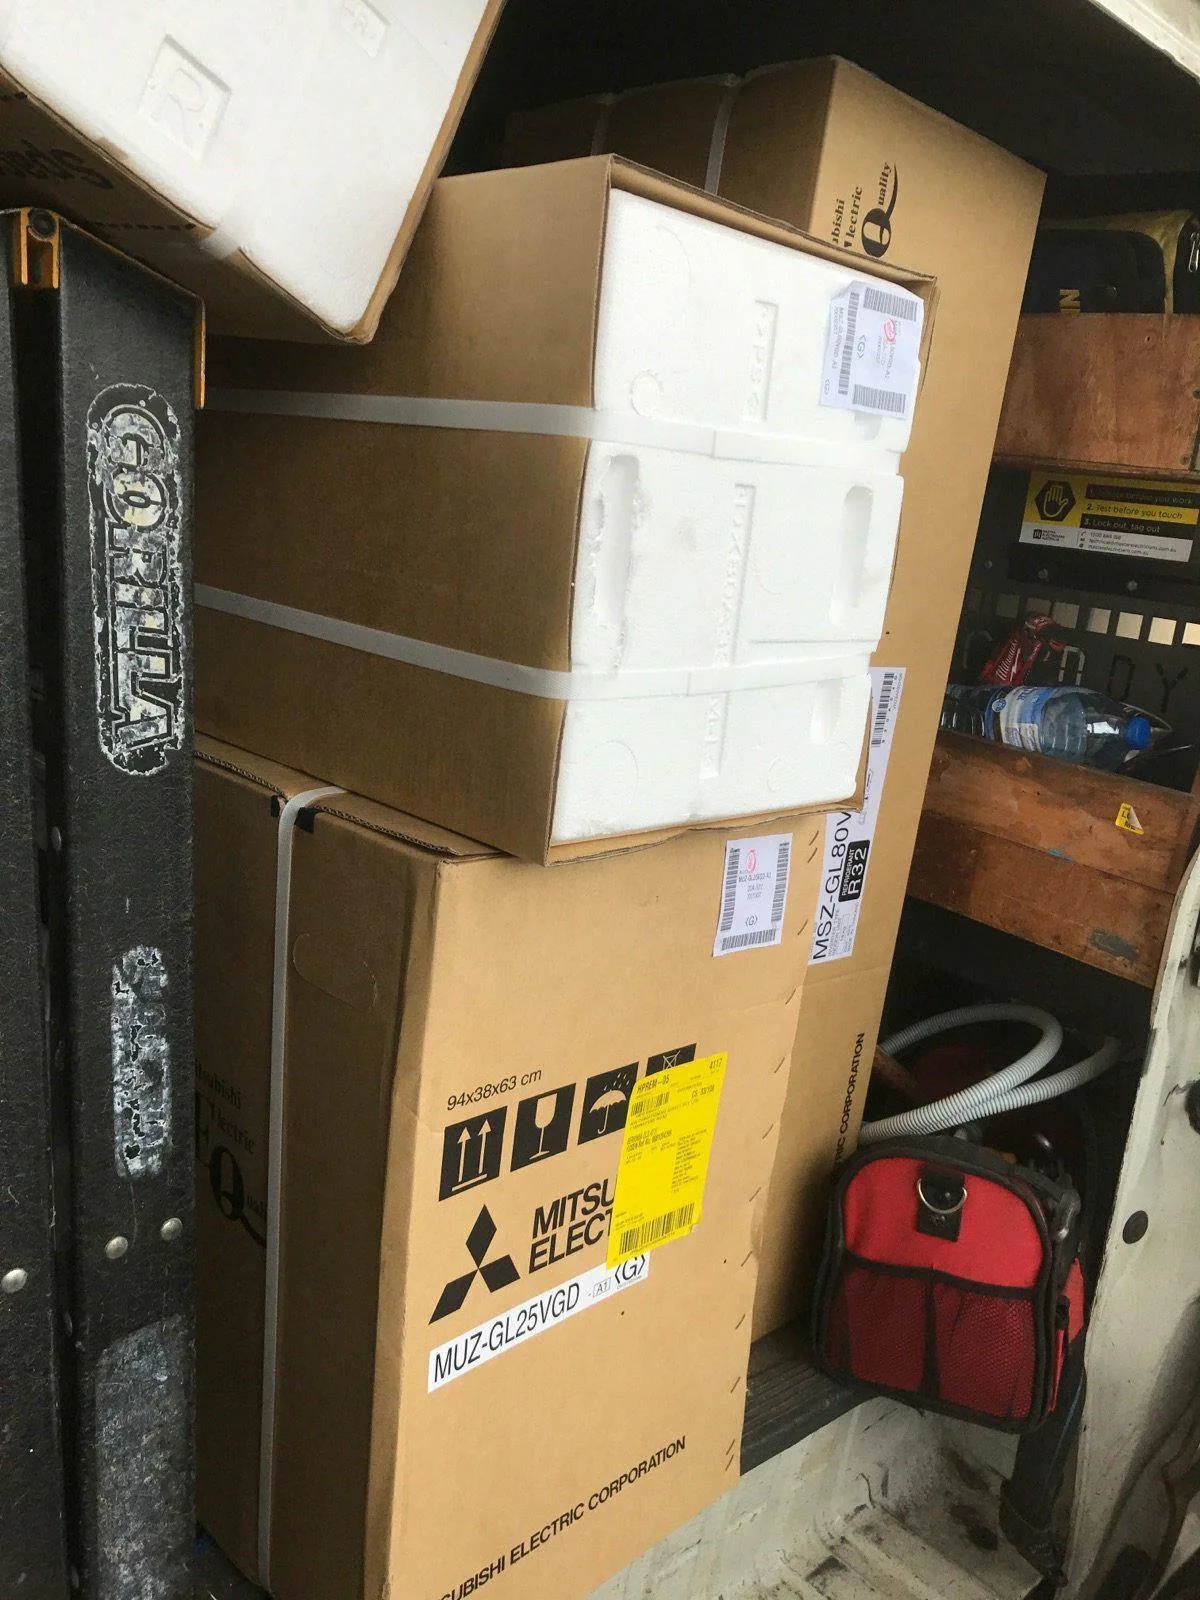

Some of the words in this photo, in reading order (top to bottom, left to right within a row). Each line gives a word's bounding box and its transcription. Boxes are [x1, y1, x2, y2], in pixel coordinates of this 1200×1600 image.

[843, 186, 862, 248] lectric
[1112, 505, 1140, 516] before
[1141, 509, 1157, 518] you
[1158, 509, 1183, 520] touch
[103, 402, 177, 755] GORILLA
[847, 847, 867, 896] R32
[446, 1076, 517, 1111] 94x38x63
[520, 1069, 543, 1086] cm
[839, 1032, 866, 1134] CORPORATION
[532, 1178, 615, 1240] MITSU
[433, 1282, 581, 1383] MUZ-GL25VGD
[509, 1502, 585, 1566] ELECTRIC
[587, 1434, 687, 1511] CORPORATION
